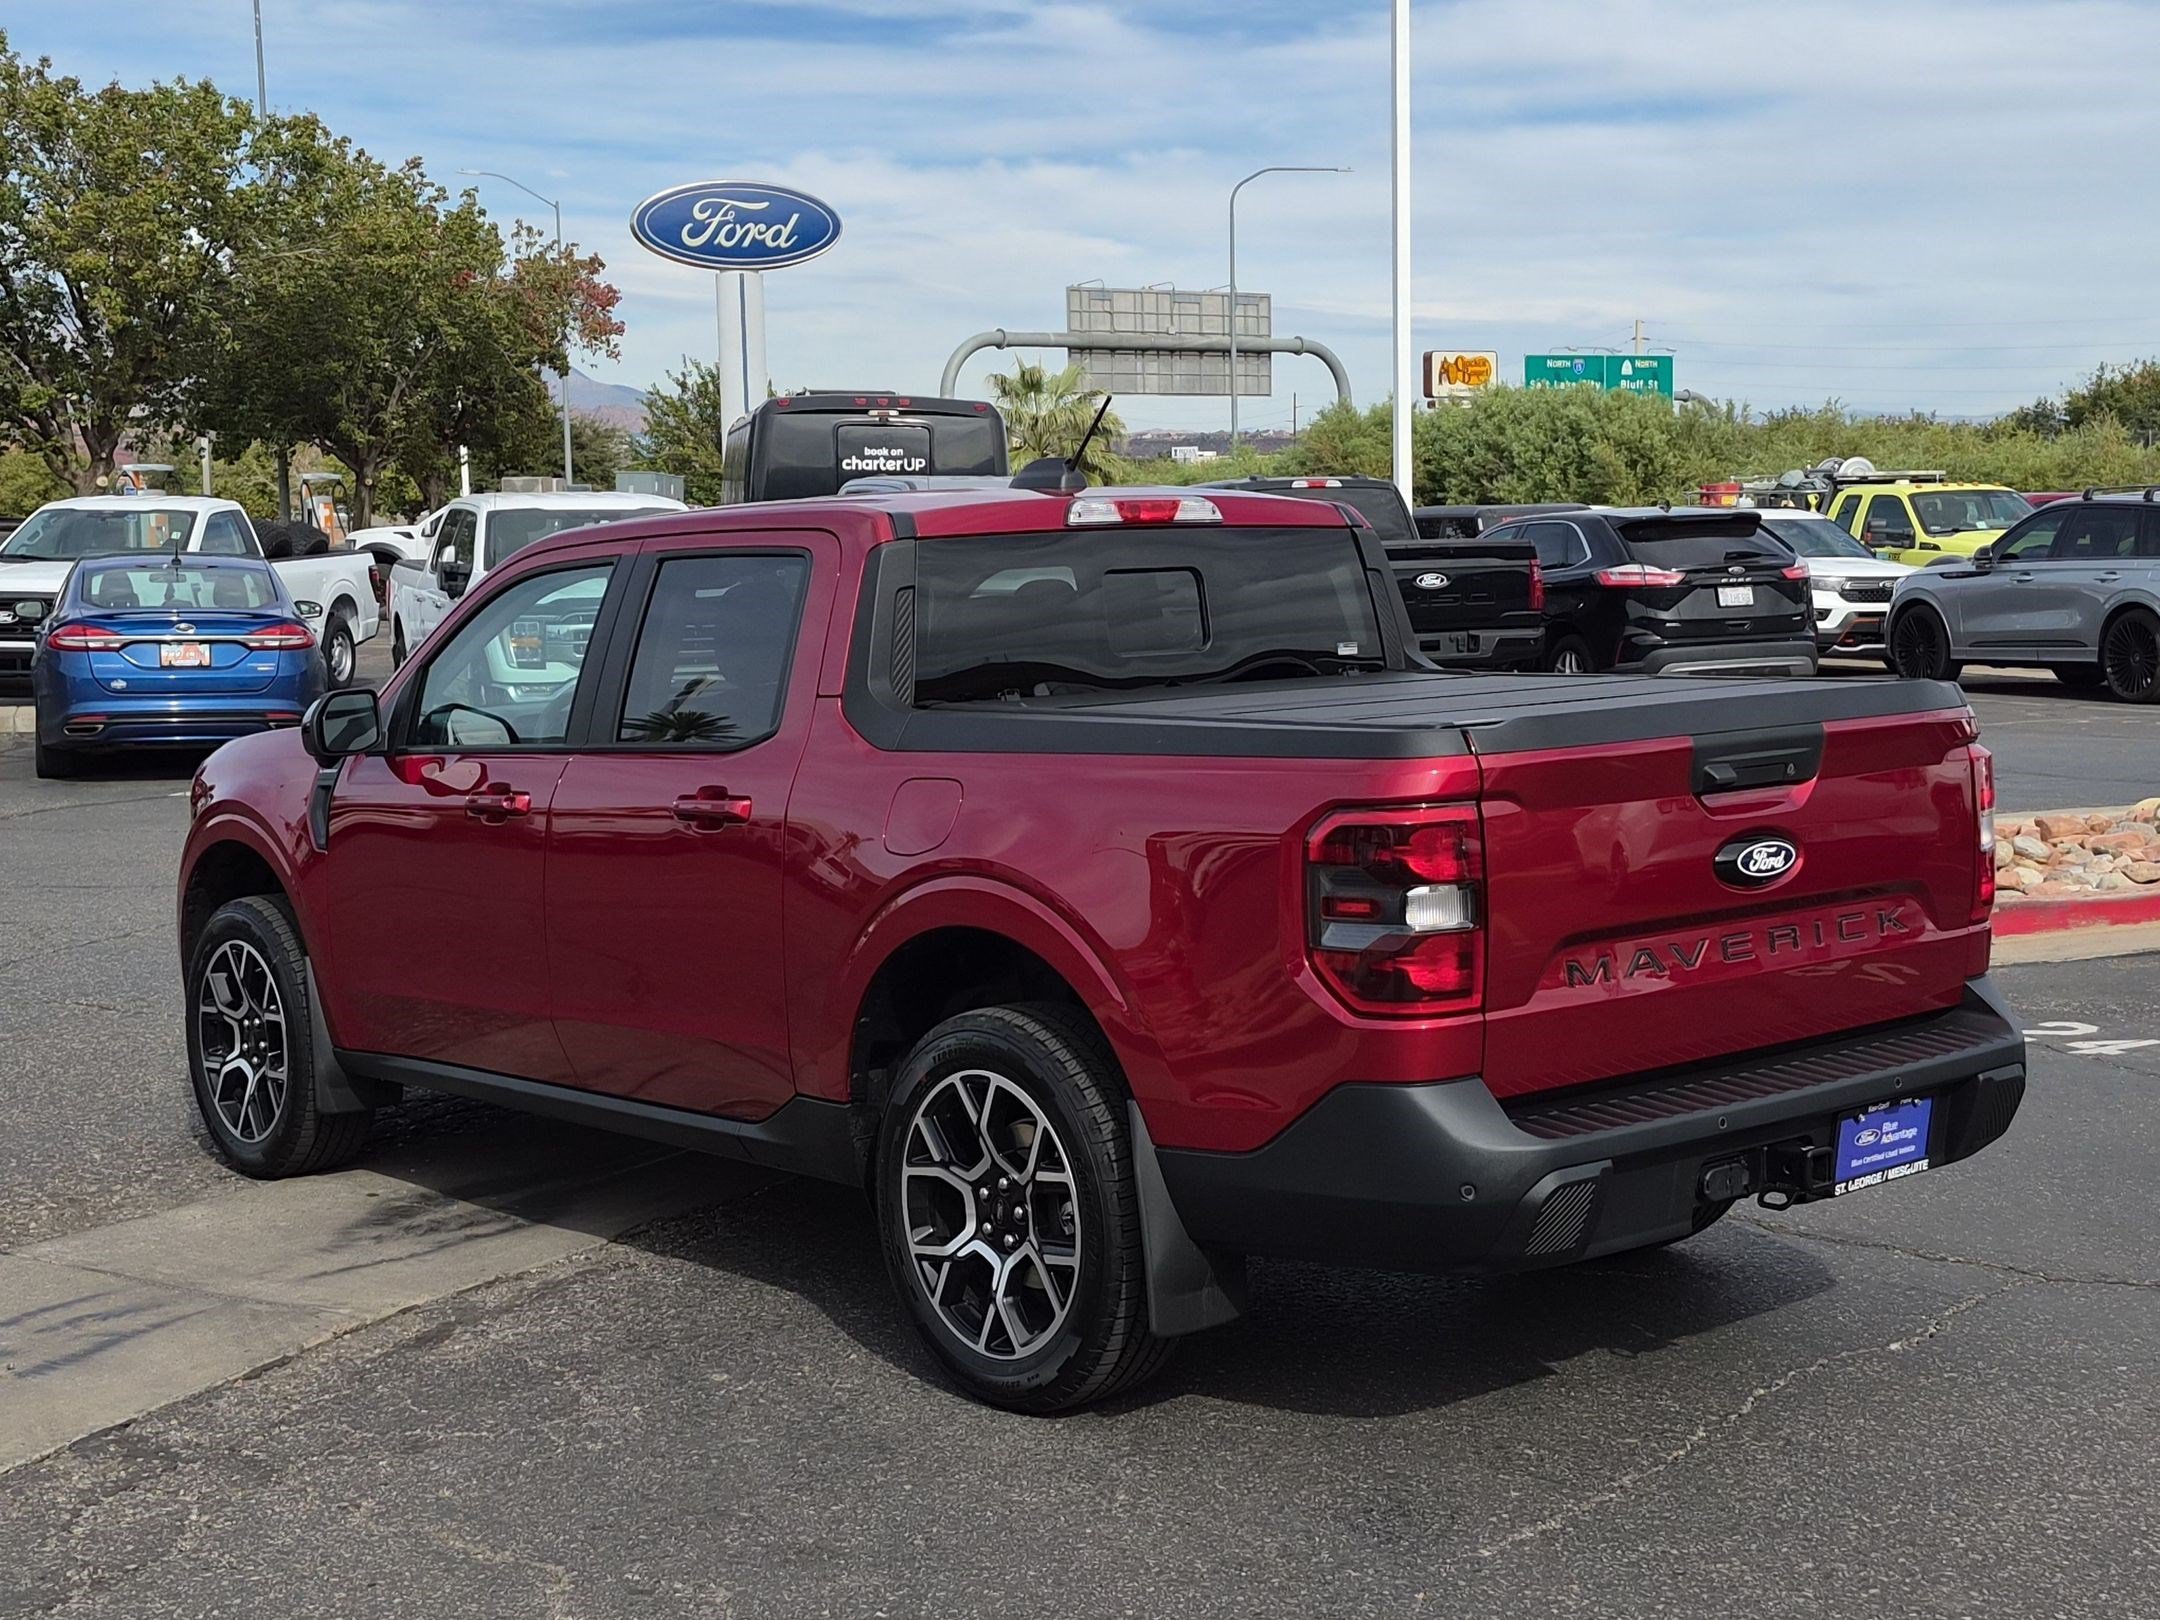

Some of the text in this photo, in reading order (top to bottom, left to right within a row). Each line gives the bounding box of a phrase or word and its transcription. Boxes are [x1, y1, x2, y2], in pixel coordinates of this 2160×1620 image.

[681, 198, 800, 249] Ford
[1529, 378, 1551, 390] Sat
[1620, 379, 1659, 390] Bluff St
[864, 446, 904, 456] book on
[841, 455, 926, 471] charterUP
[1749, 846, 1786, 871] Ford
[1564, 907, 1910, 988] MAVERICK
[1848, 1171, 1882, 1191] GEORGE
